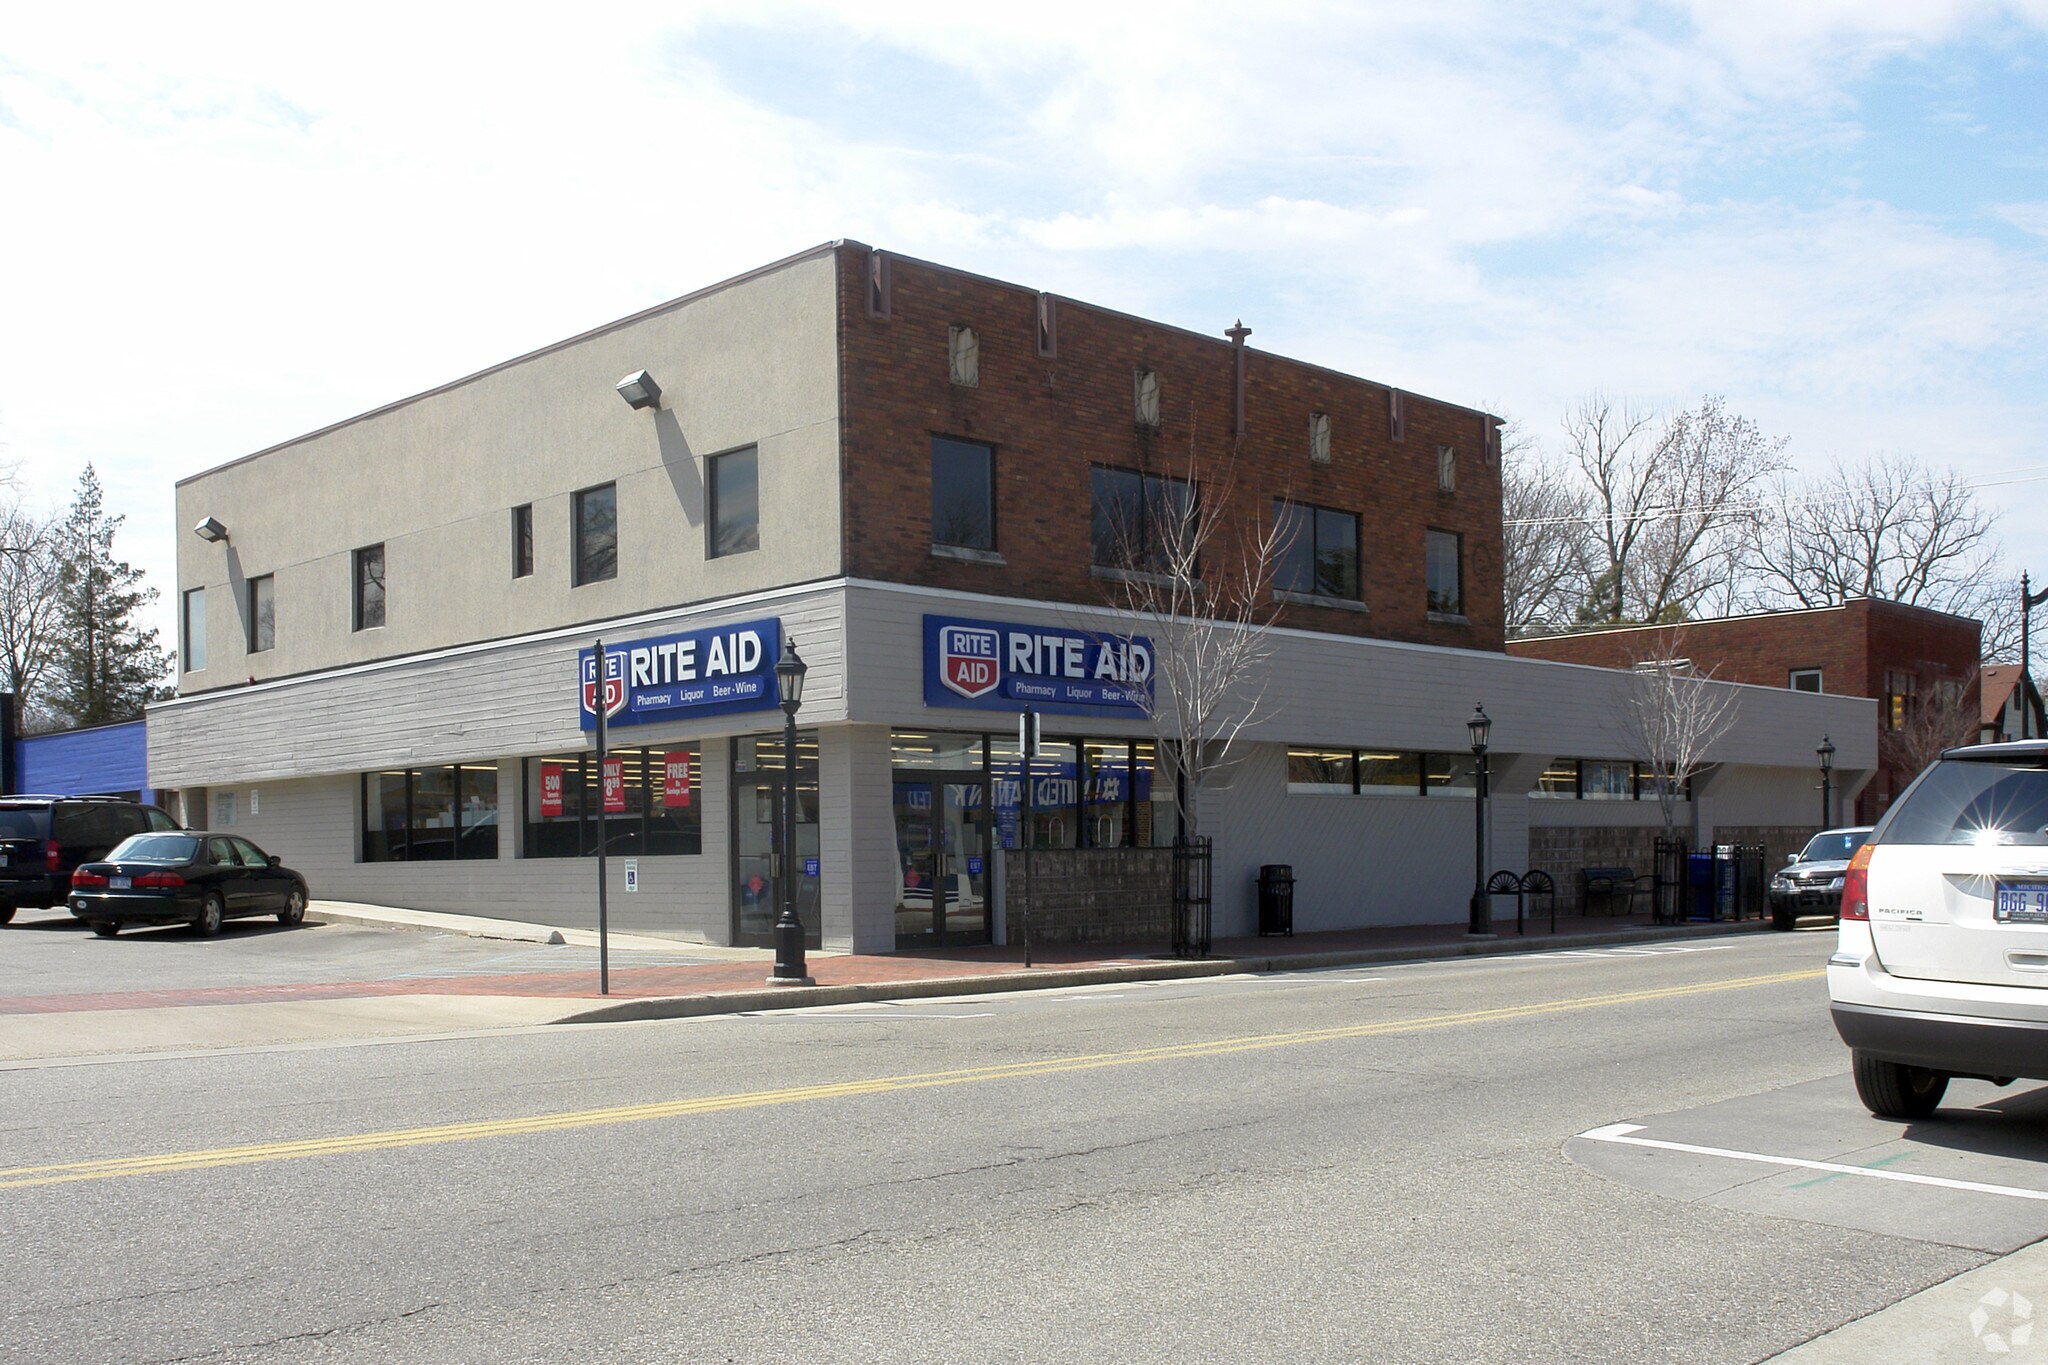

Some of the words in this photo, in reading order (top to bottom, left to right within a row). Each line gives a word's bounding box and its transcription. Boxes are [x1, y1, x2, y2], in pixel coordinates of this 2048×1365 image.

[953, 633, 991, 654] RITE
[631, 640, 696, 687] RITE
[705, 630, 762, 677] AID
[1008, 632, 1085, 678] RITE
[1094, 641, 1150, 682] AID
[589, 658, 617, 680] RE
[956, 662, 989, 684] AID
[637, 693, 672, 706] Pharmacy
[680, 689, 704, 701] Liquor
[1016, 682, 1056, 697] Pharmacy
[1066, 686, 1092, 700] Liquor
[667, 762, 688, 779] FREE
[545, 775, 560, 790] 500
[2000, 892, 2027, 912] BGG
